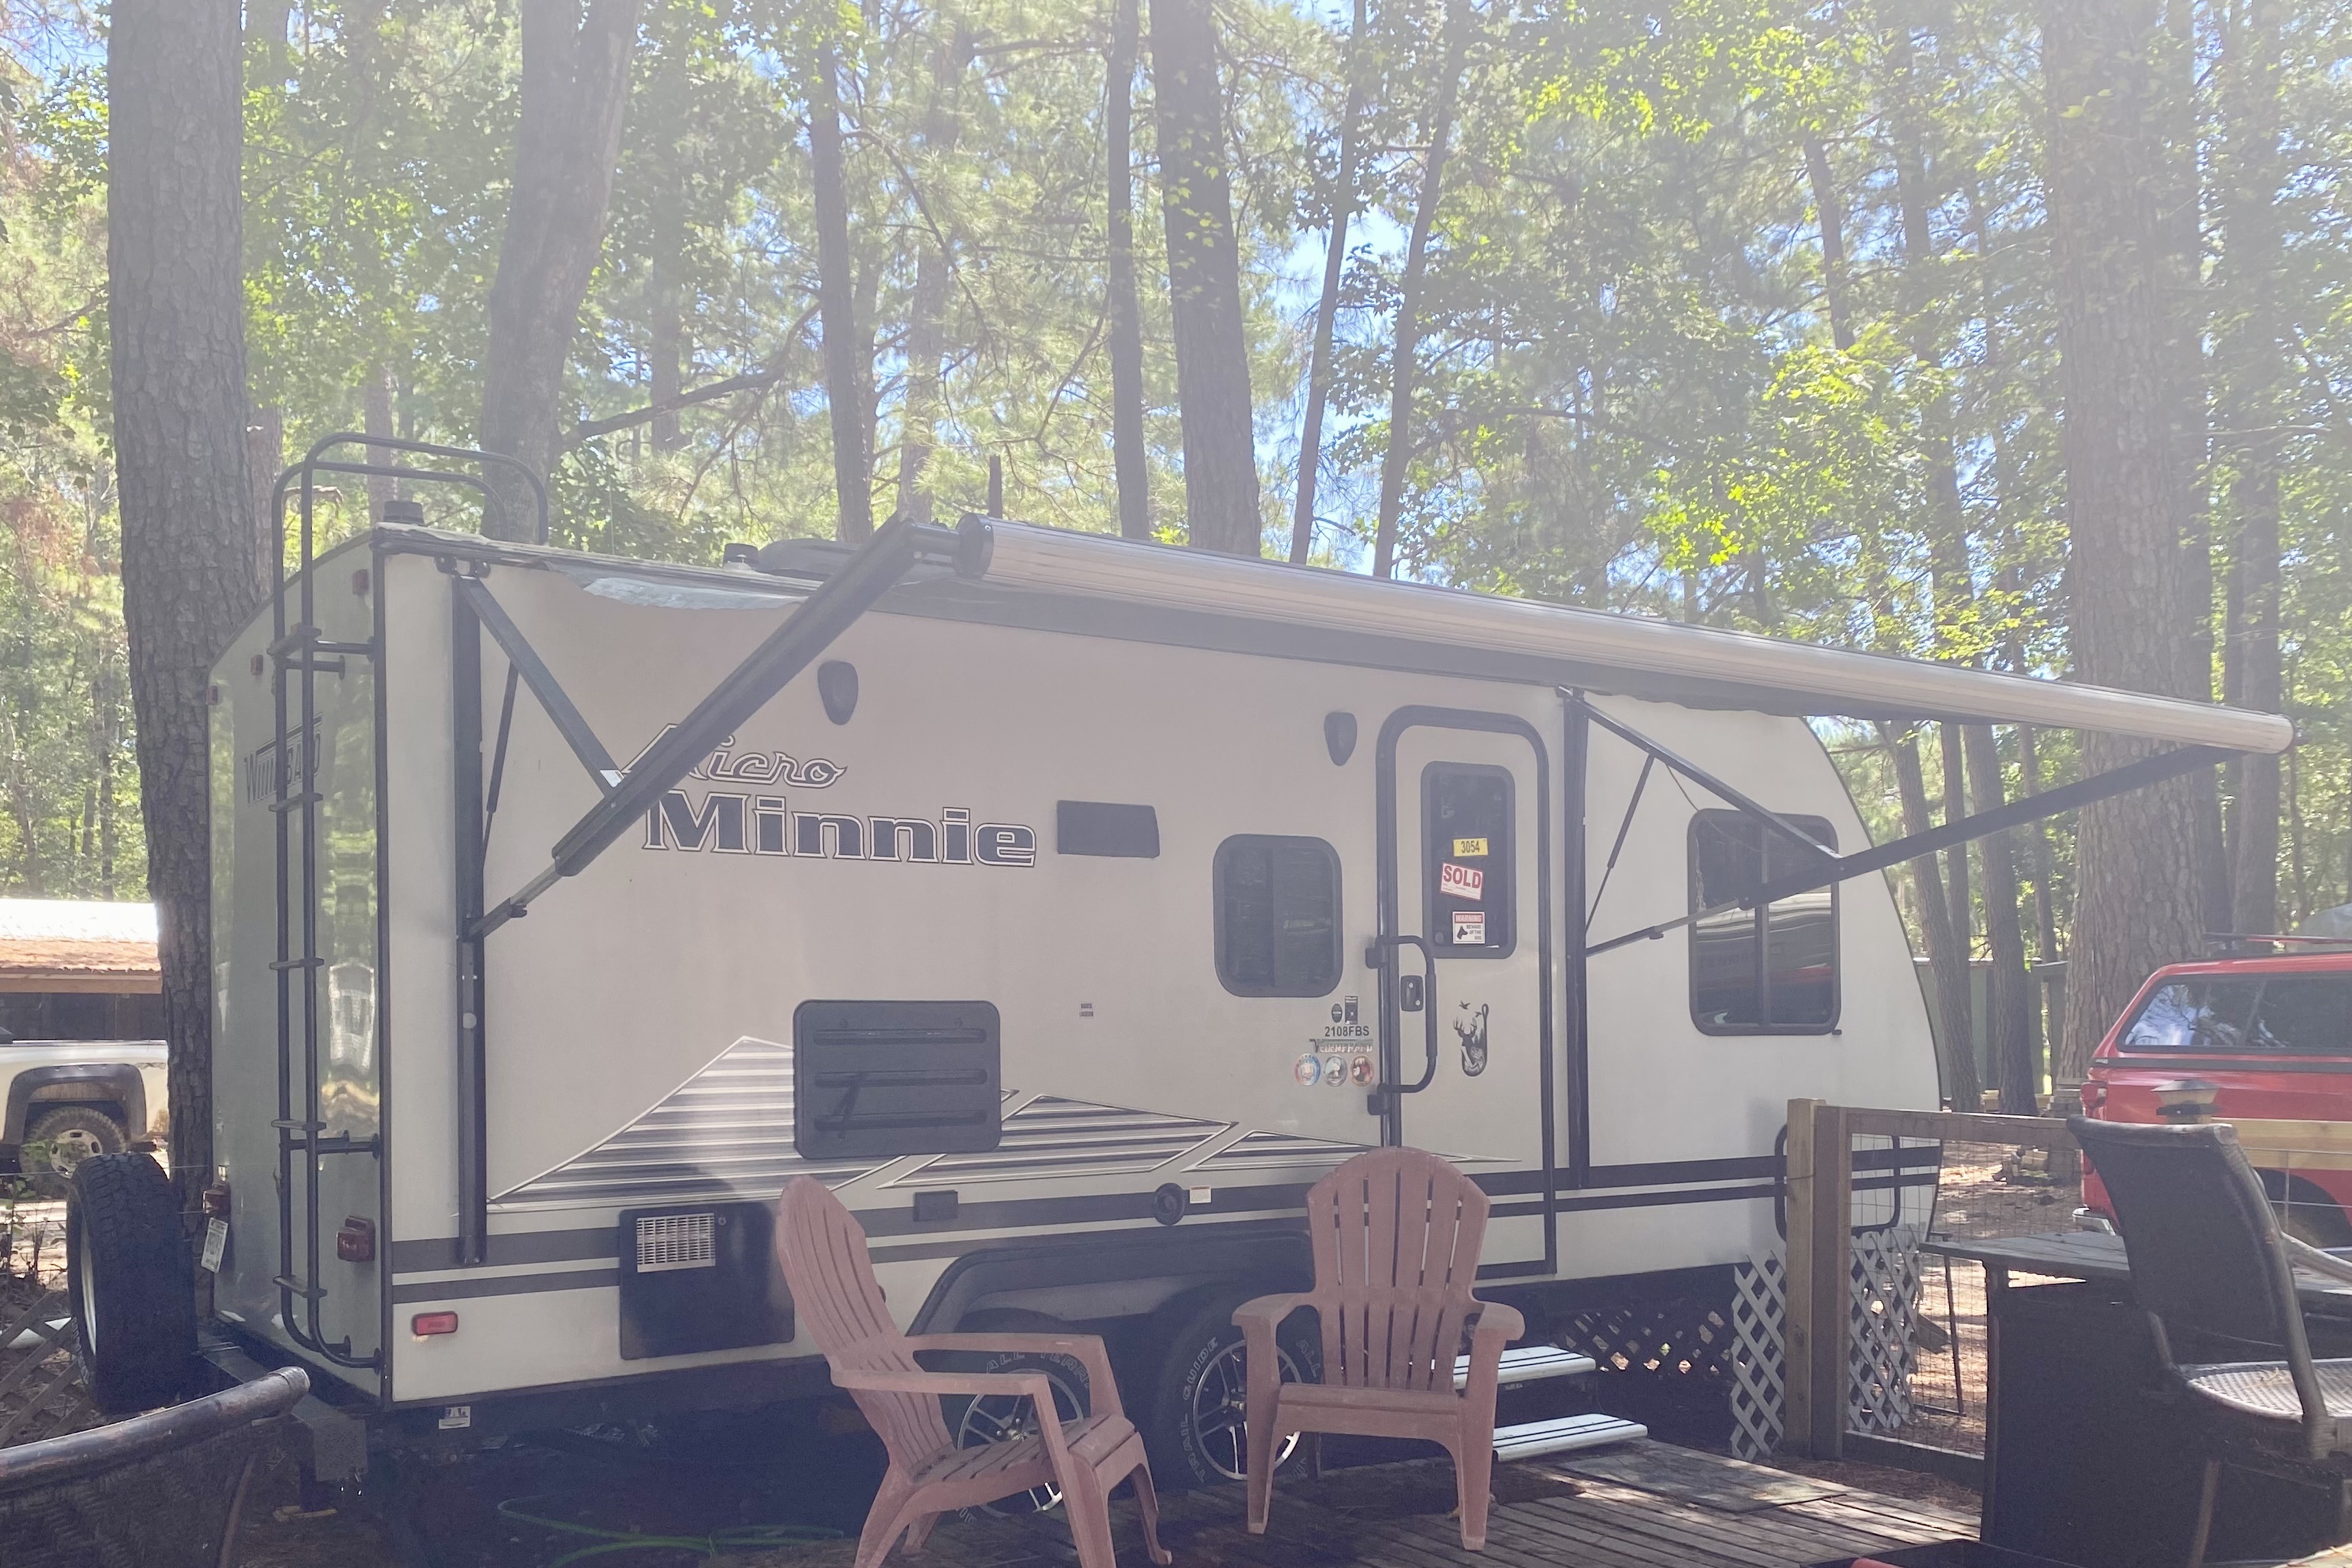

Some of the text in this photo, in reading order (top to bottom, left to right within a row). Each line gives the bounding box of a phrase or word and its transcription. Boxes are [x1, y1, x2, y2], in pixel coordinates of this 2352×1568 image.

[620, 723, 847, 788] icro
[641, 789, 1037, 868] Minnie
[1461, 840, 1480, 854] 3054
[1443, 865, 1481, 888] SOLD
[1455, 914, 1482, 923] WARNING
[1324, 1025, 1370, 1037] 2108FBS
[986, 1352, 1025, 1373] ALL
[1180, 1336, 1218, 1484] TRAIL GUIDE
